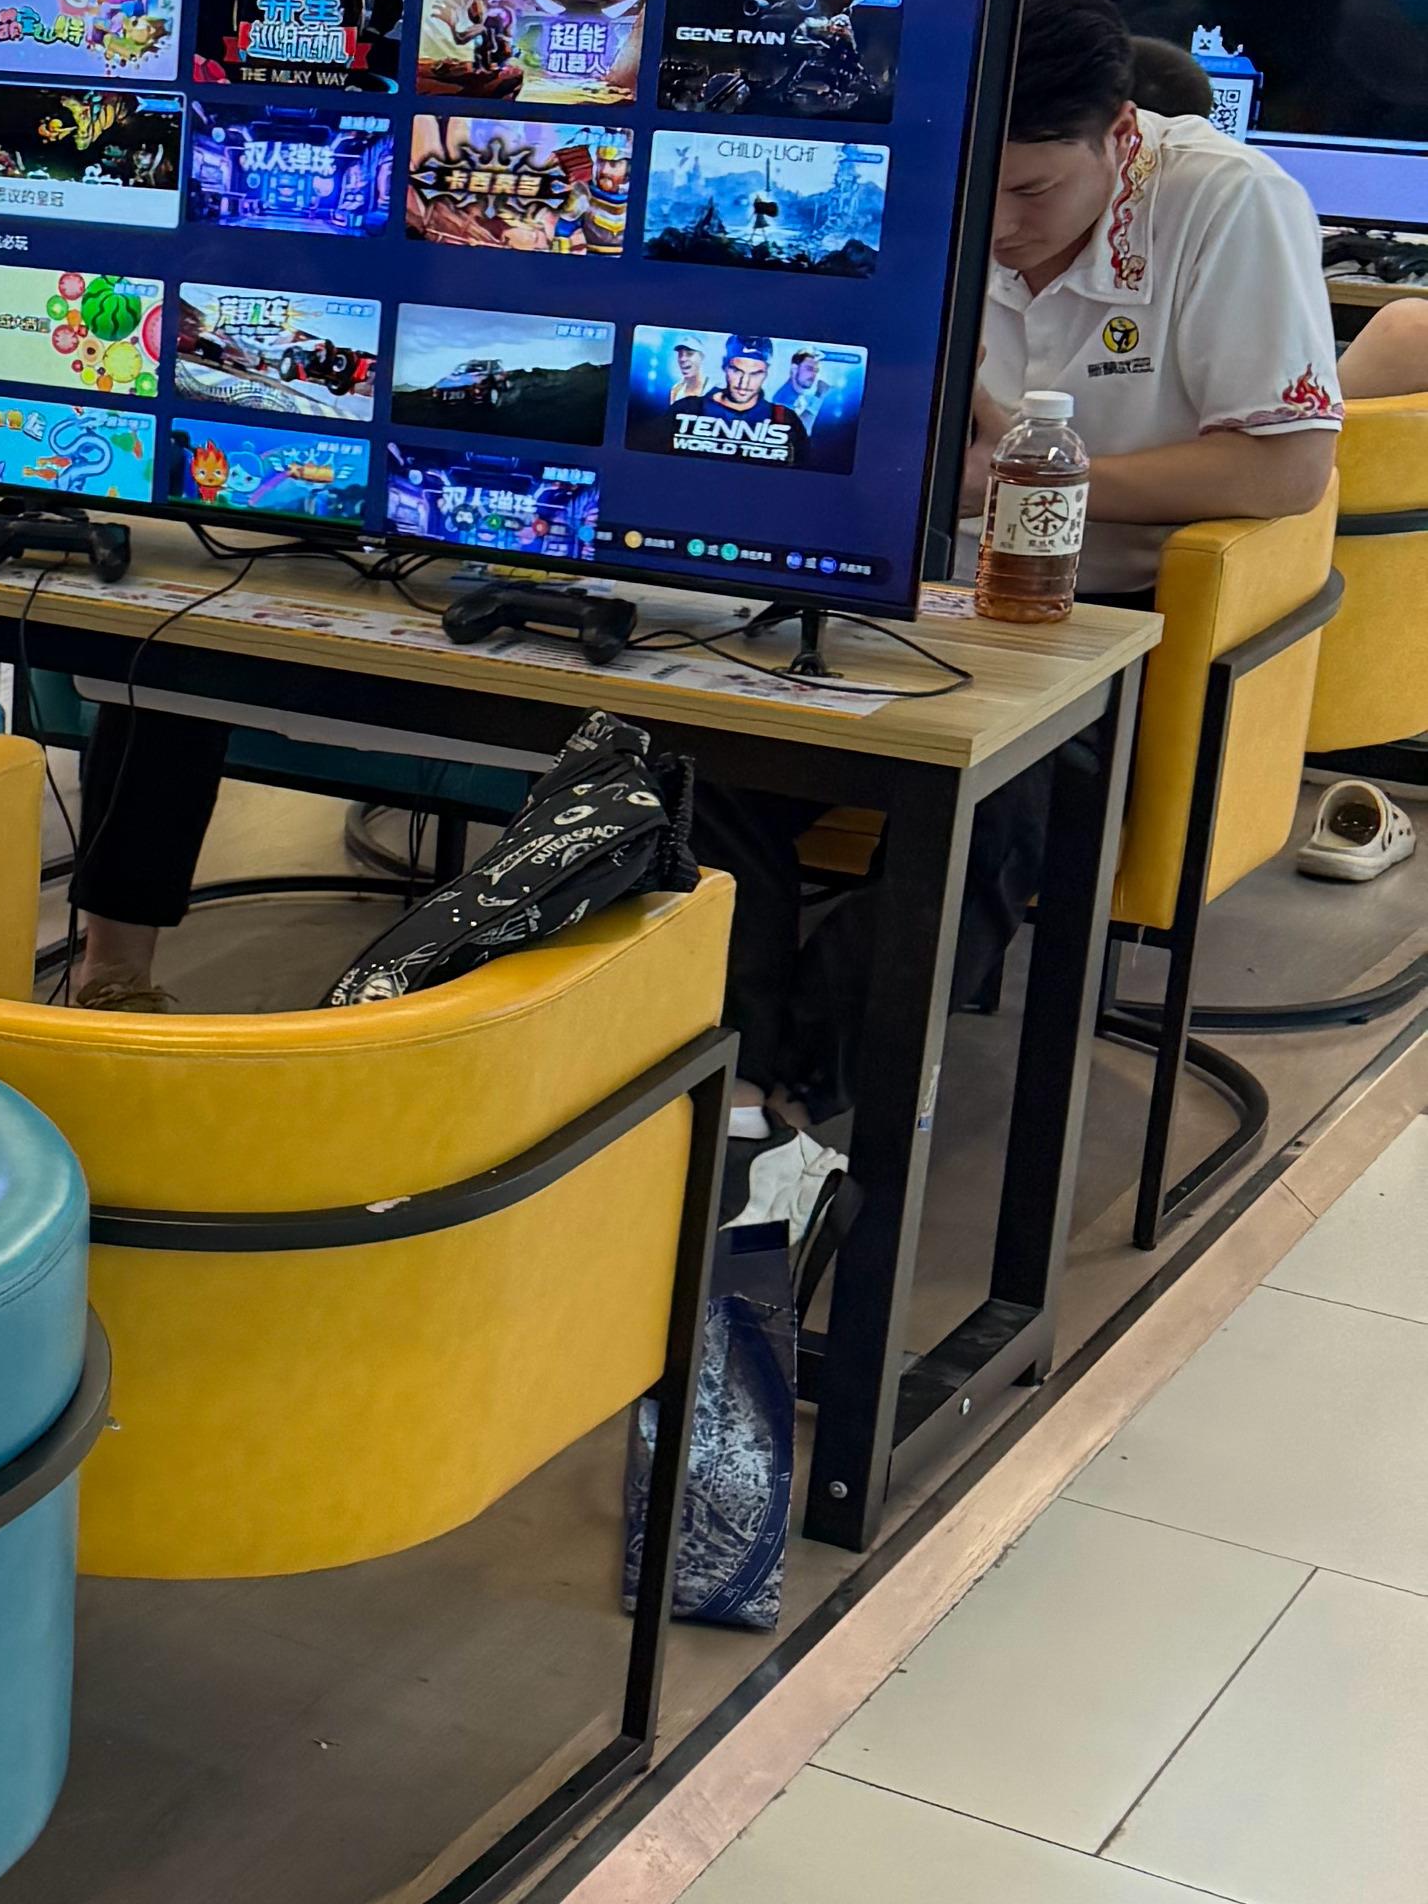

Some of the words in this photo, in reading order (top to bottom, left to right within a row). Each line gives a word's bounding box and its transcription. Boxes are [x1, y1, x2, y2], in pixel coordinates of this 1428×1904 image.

[548, 22, 608, 53] 超能
[675, 26, 733, 43] GENE
[736, 29, 786, 47] RAIN
[546, 52, 608, 75] 机器人
[240, 67, 267, 82] THE
[271, 69, 313, 84] MILKY
[316, 71, 349, 86] WAY
[717, 139, 764, 161] CHILD
[773, 143, 819, 164] LIGHT
[674, 413, 792, 445] TENNIS
[672, 437, 738, 457] WORLD
[741, 442, 790, 462] TOUR
